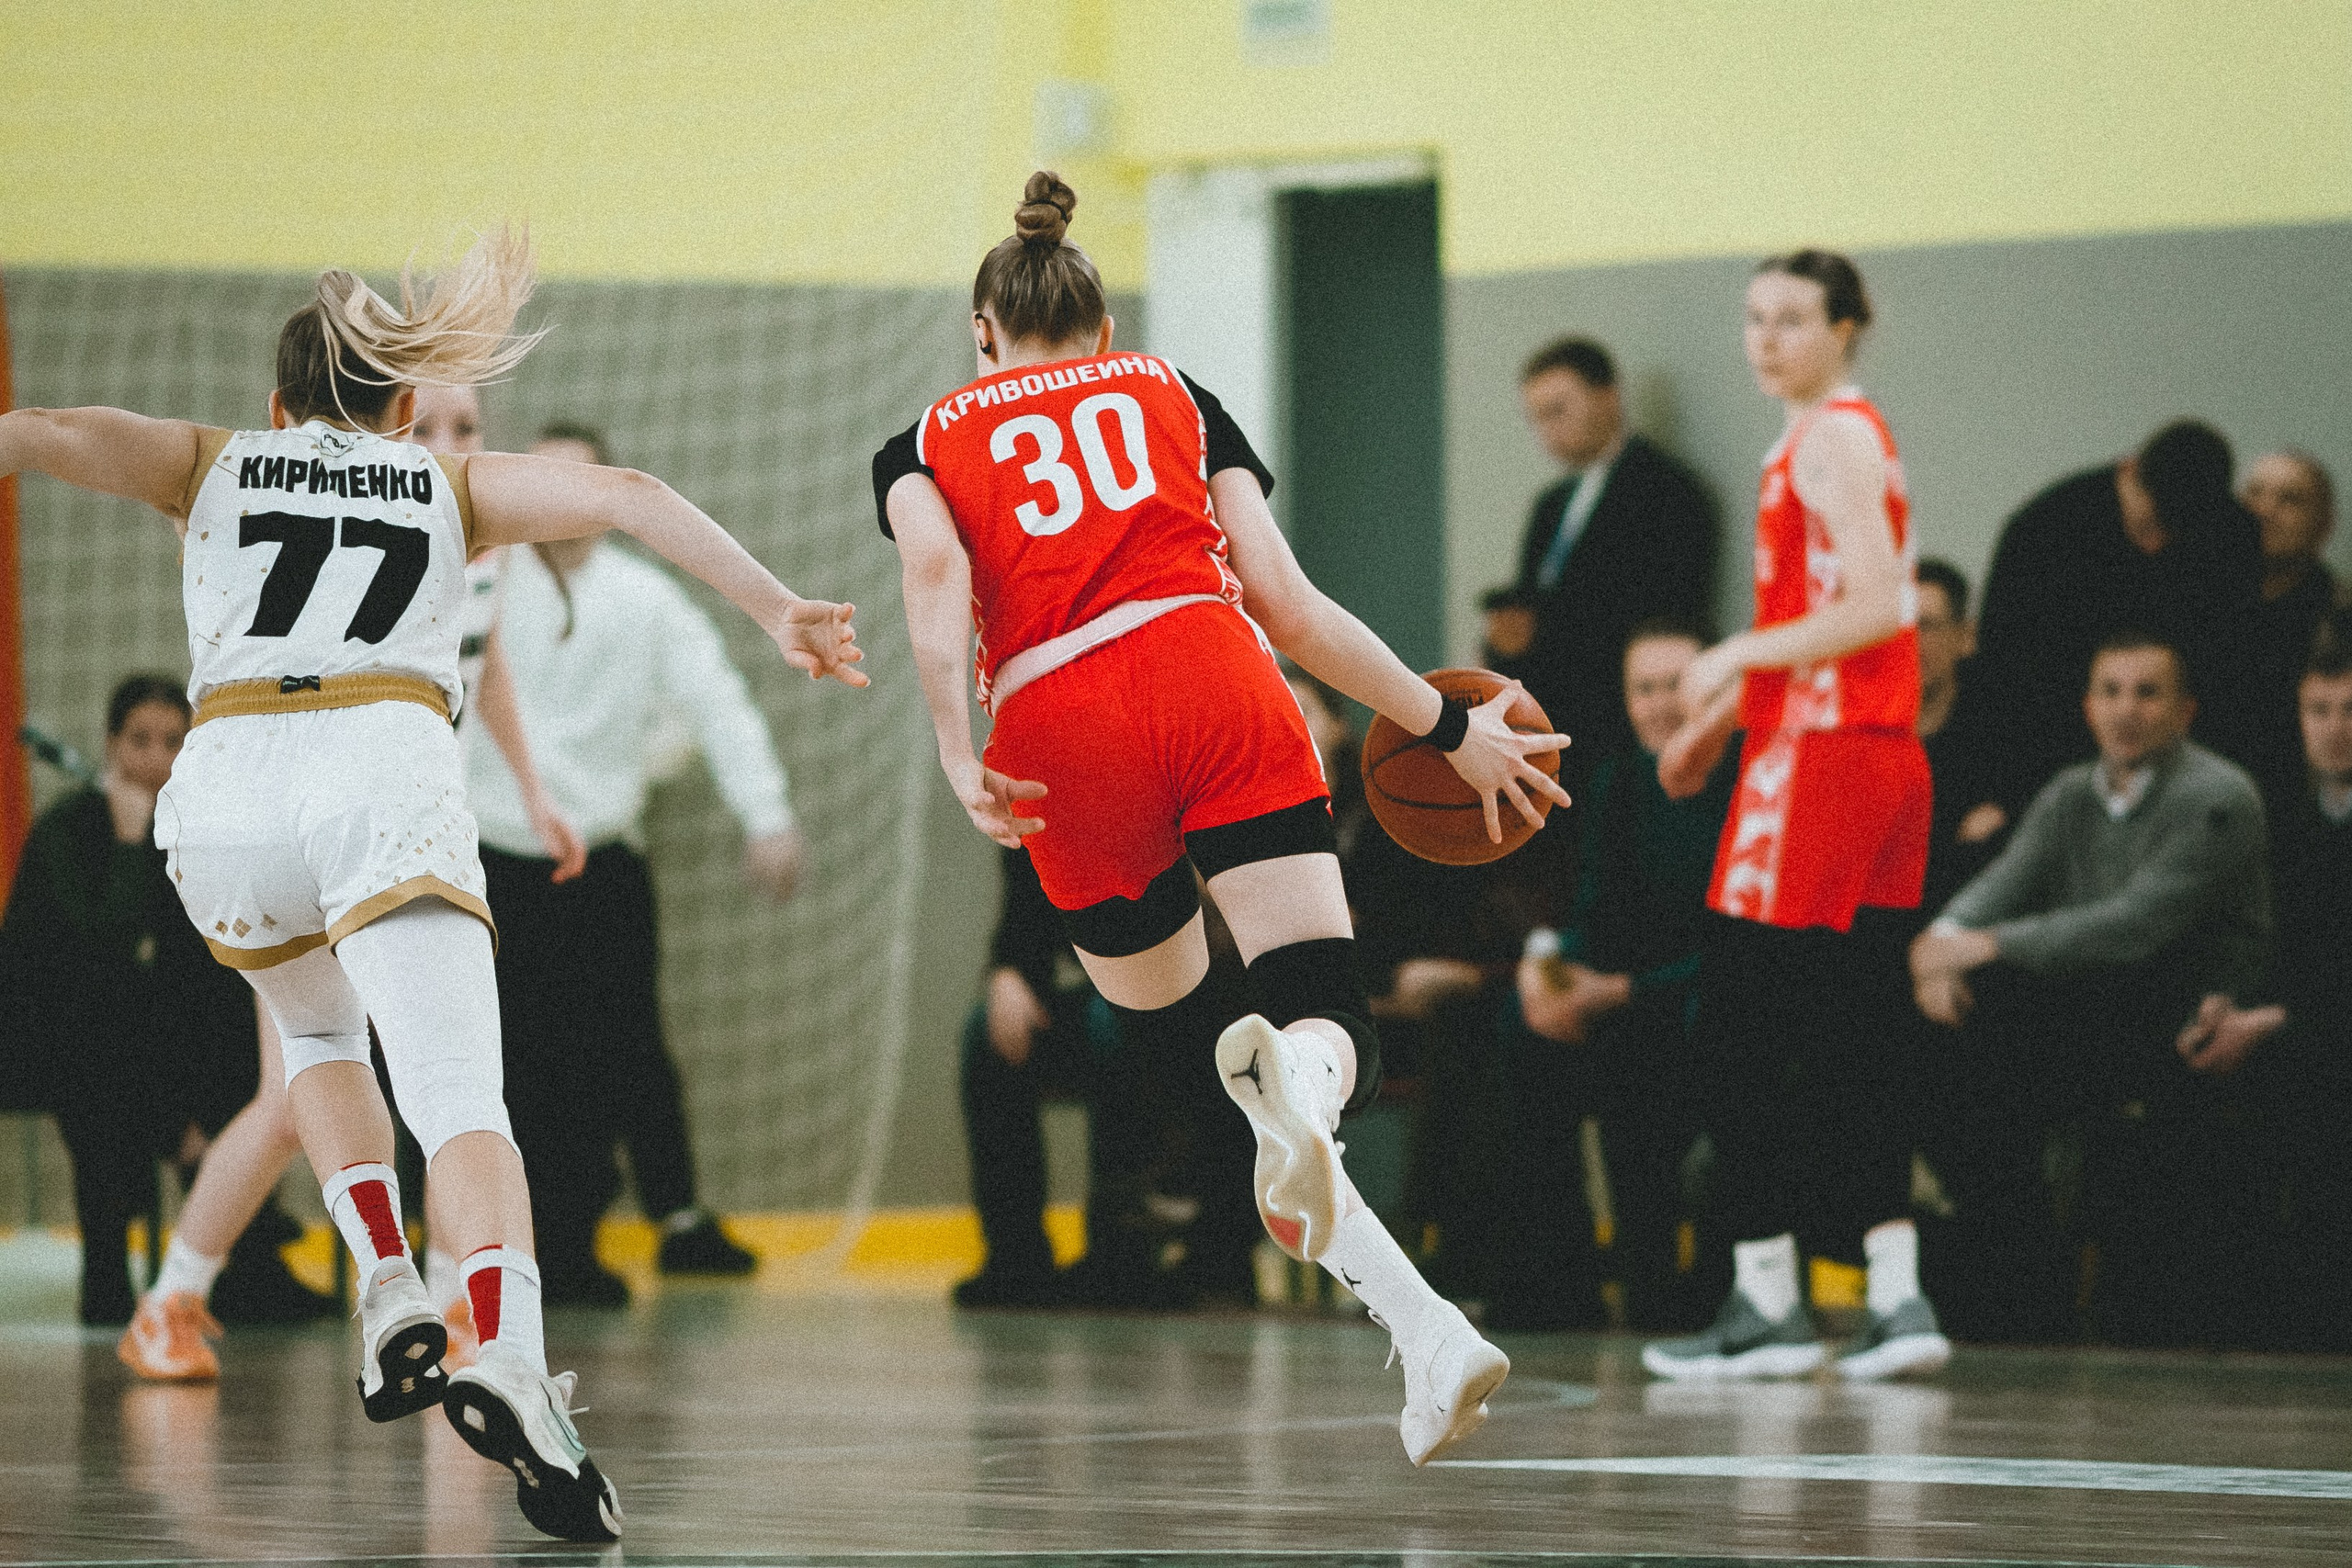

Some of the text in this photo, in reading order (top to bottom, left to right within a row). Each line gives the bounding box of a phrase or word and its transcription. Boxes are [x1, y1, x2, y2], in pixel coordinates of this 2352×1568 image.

[935, 355, 1169, 431] КРИВОШЕИНА
[239, 455, 432, 505] КИРИЛЕНКО
[989, 392, 1156, 536] 30
[239, 511, 430, 645] 77
